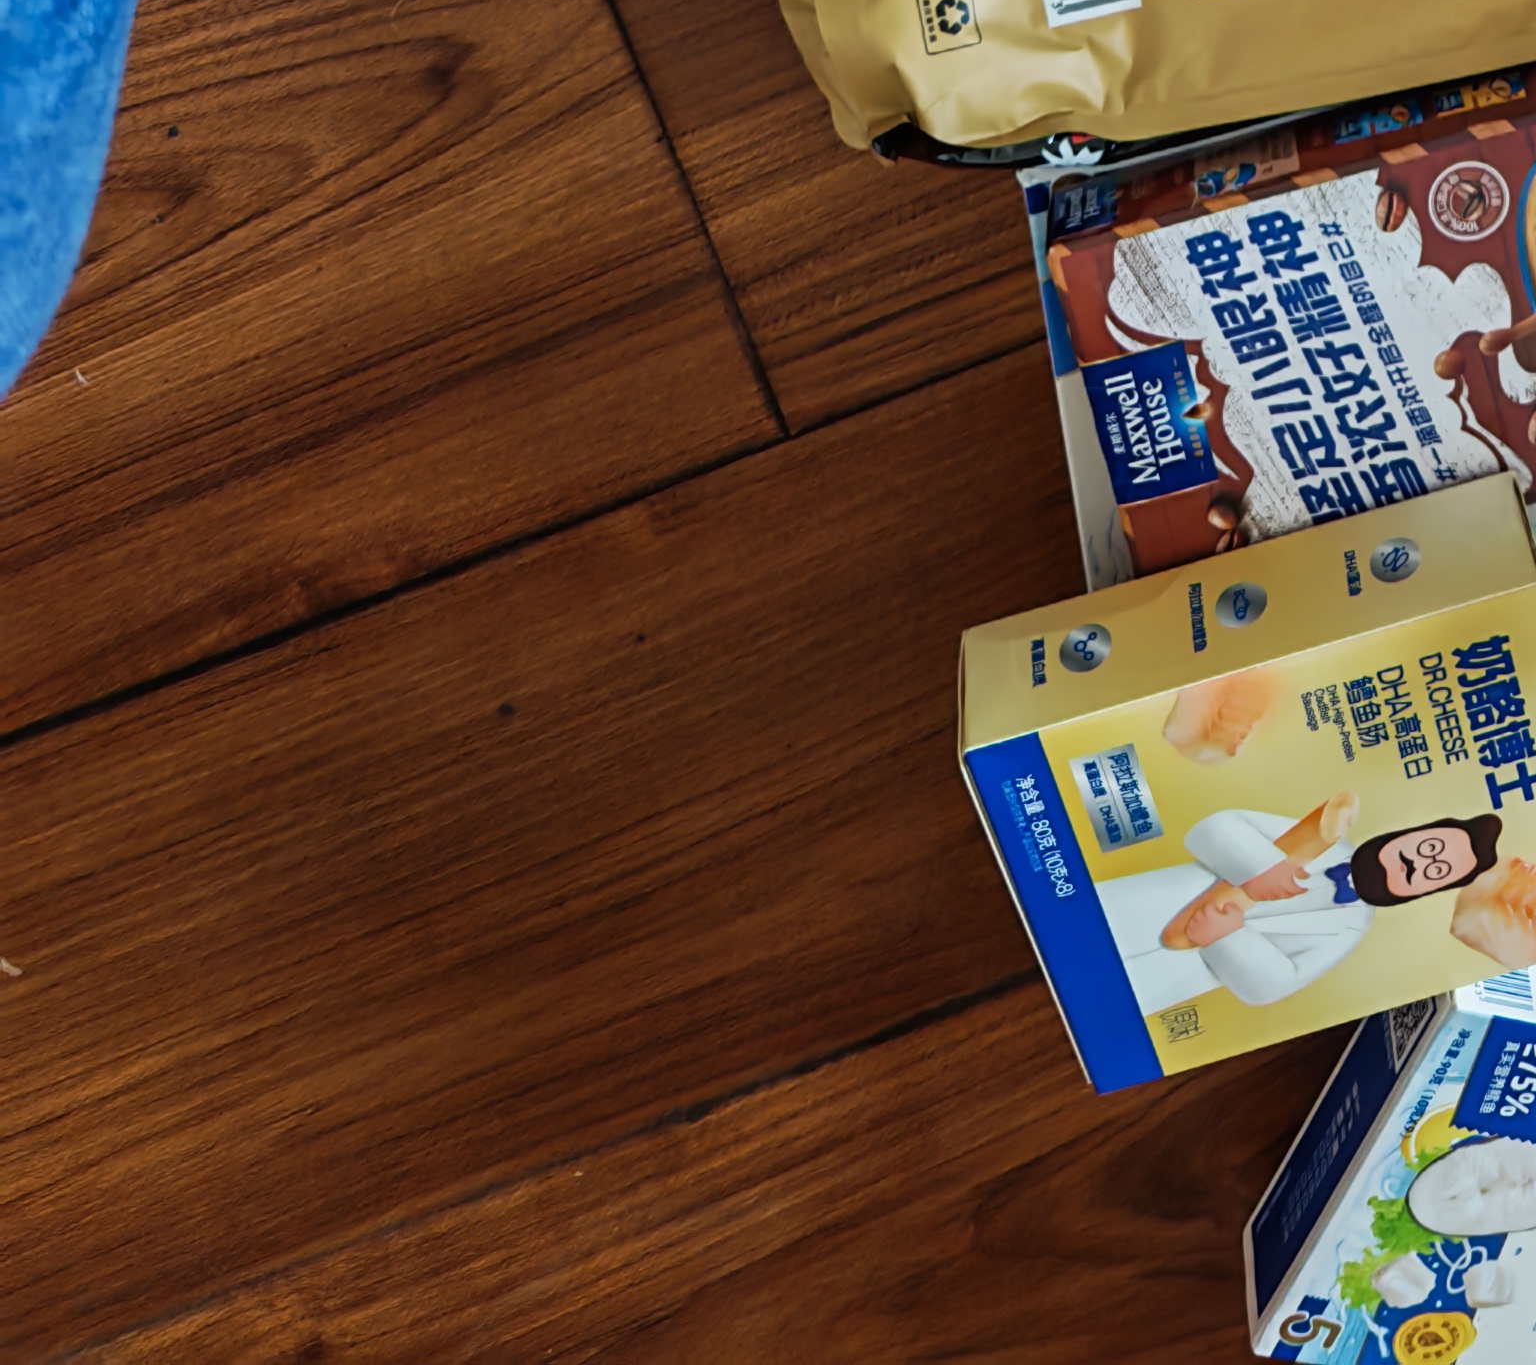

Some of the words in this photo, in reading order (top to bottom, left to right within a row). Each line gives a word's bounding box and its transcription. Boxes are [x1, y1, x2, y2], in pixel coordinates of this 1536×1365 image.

[1182, 223, 1366, 524] 坚定小眼神
[1243, 205, 1429, 509] 香浓好精神
[1319, 219, 1458, 485] #一滴香浓开启全醒的自己#
[1103, 370, 1161, 487] Maxwell
[1103, 410, 1127, 455] 麦斯威尔
[1136, 375, 1187, 467] House
[1298, 691, 1322, 732] Sausage
[1311, 687, 1333, 723] Codfish
[1324, 684, 1341, 706] DHA
[1341, 673, 1391, 750] 鳕鱼肠
[1374, 663, 1435, 780] DHA高蛋白
[1418, 652, 1468, 765] DR.CHEESE
[1108, 751, 1154, 837] 阿拉斯加鳕鱼
